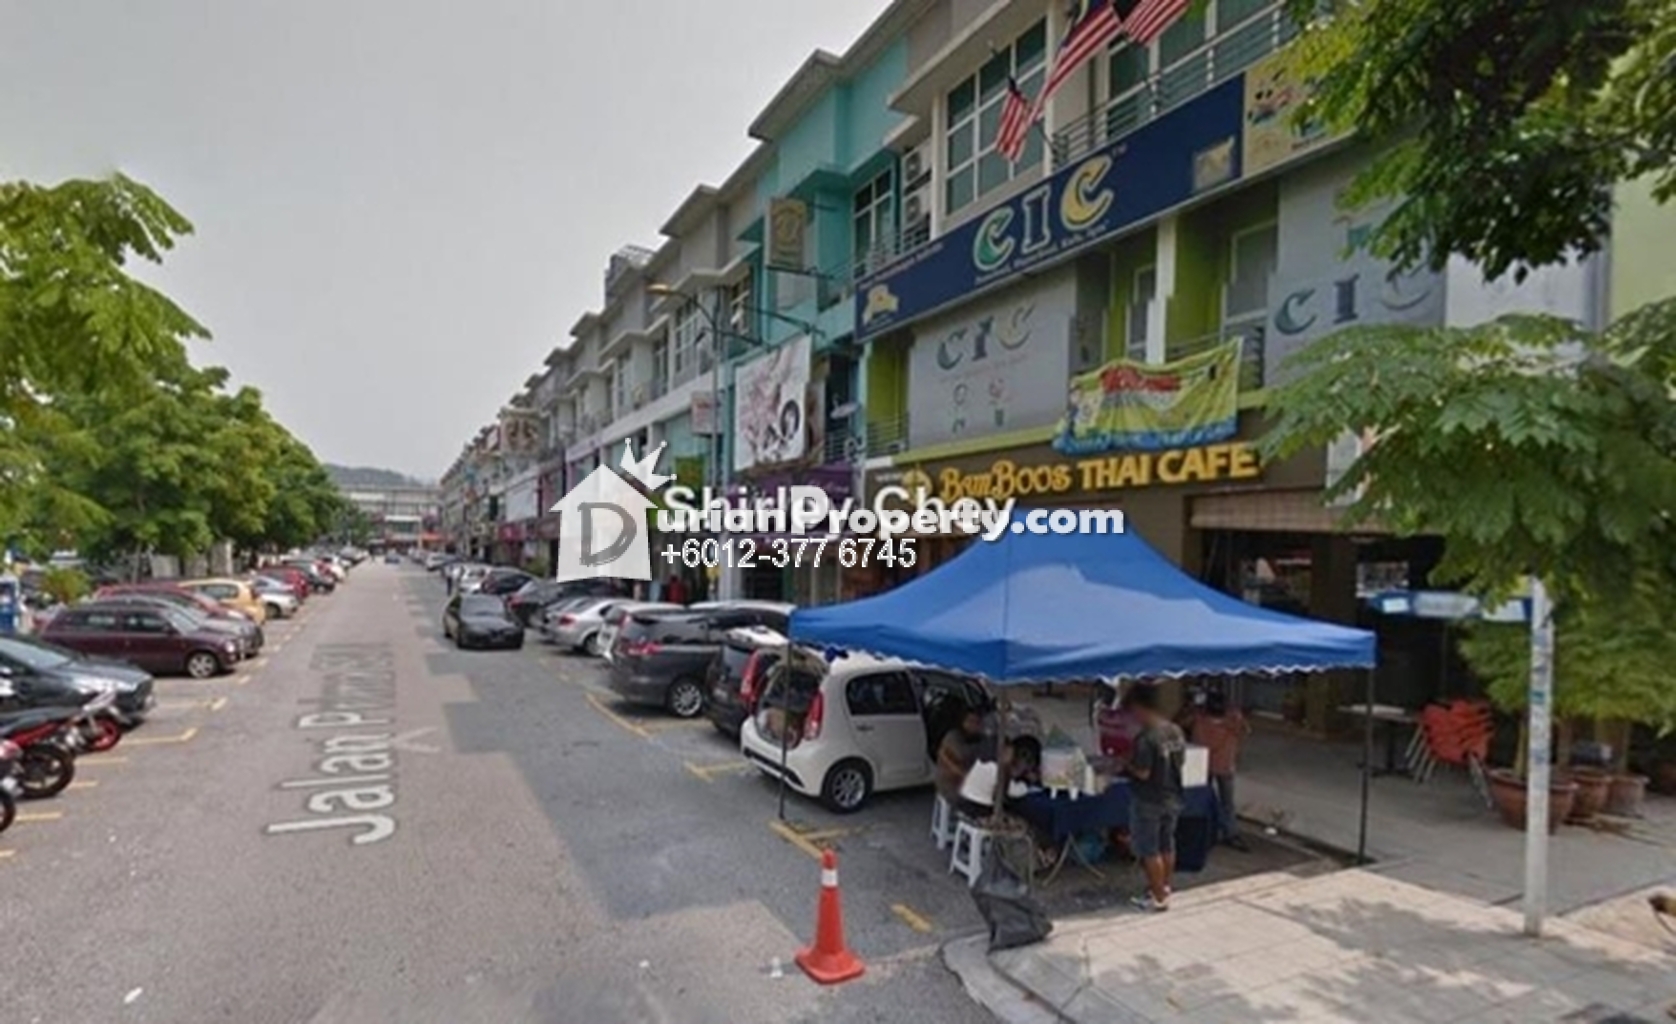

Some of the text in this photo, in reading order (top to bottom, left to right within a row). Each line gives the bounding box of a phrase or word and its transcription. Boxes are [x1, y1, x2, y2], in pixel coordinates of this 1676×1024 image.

[973, 153, 1114, 272] CIC
[936, 303, 1036, 370] CIC
[1077, 454, 1151, 490] THAI
[1157, 443, 1259, 484] CAFE
